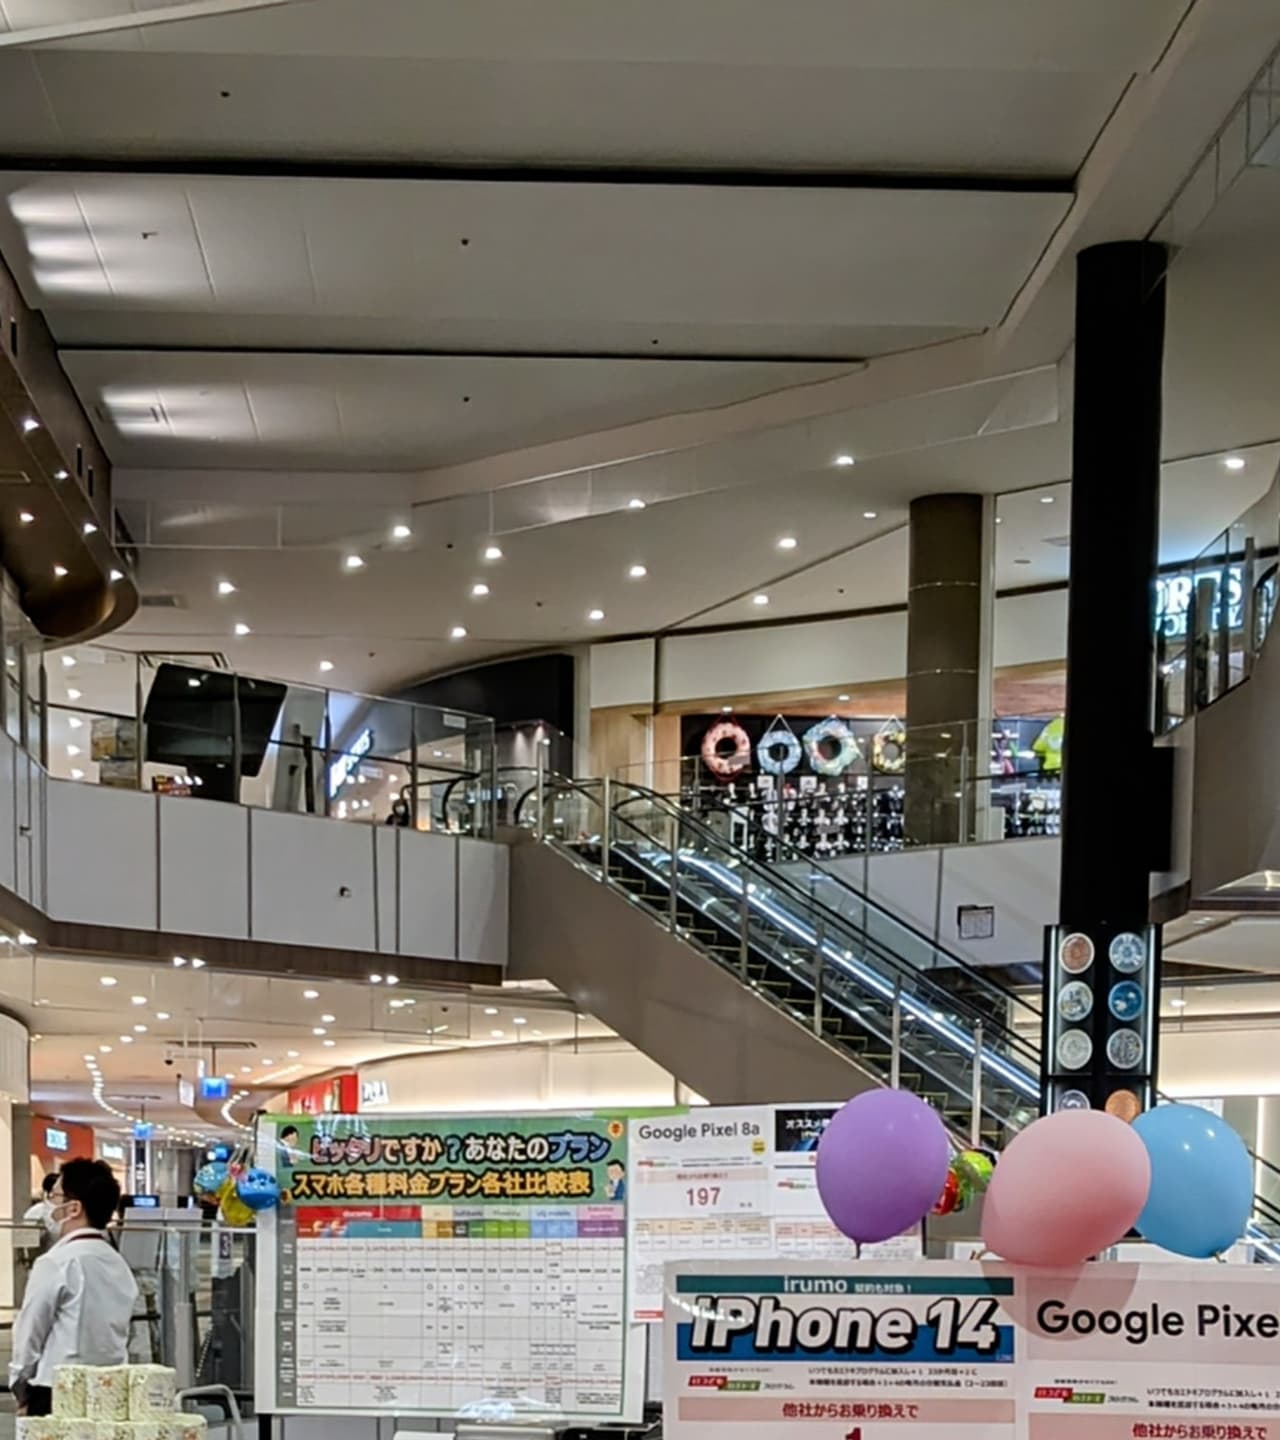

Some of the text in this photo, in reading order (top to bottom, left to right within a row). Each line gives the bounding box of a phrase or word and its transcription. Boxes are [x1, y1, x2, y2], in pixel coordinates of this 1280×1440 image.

[639, 1121, 761, 1144] Google Pixel 8a
[686, 1186, 721, 1207] 197
[783, 1275, 848, 1293] irumo
[926, 1296, 999, 1354] 14
[1037, 1299, 1184, 1345] Google
[782, 1402, 919, 1419] 他社からお乗り換えで
[1132, 1422, 1268, 1440] 他社からお乗り換えで
